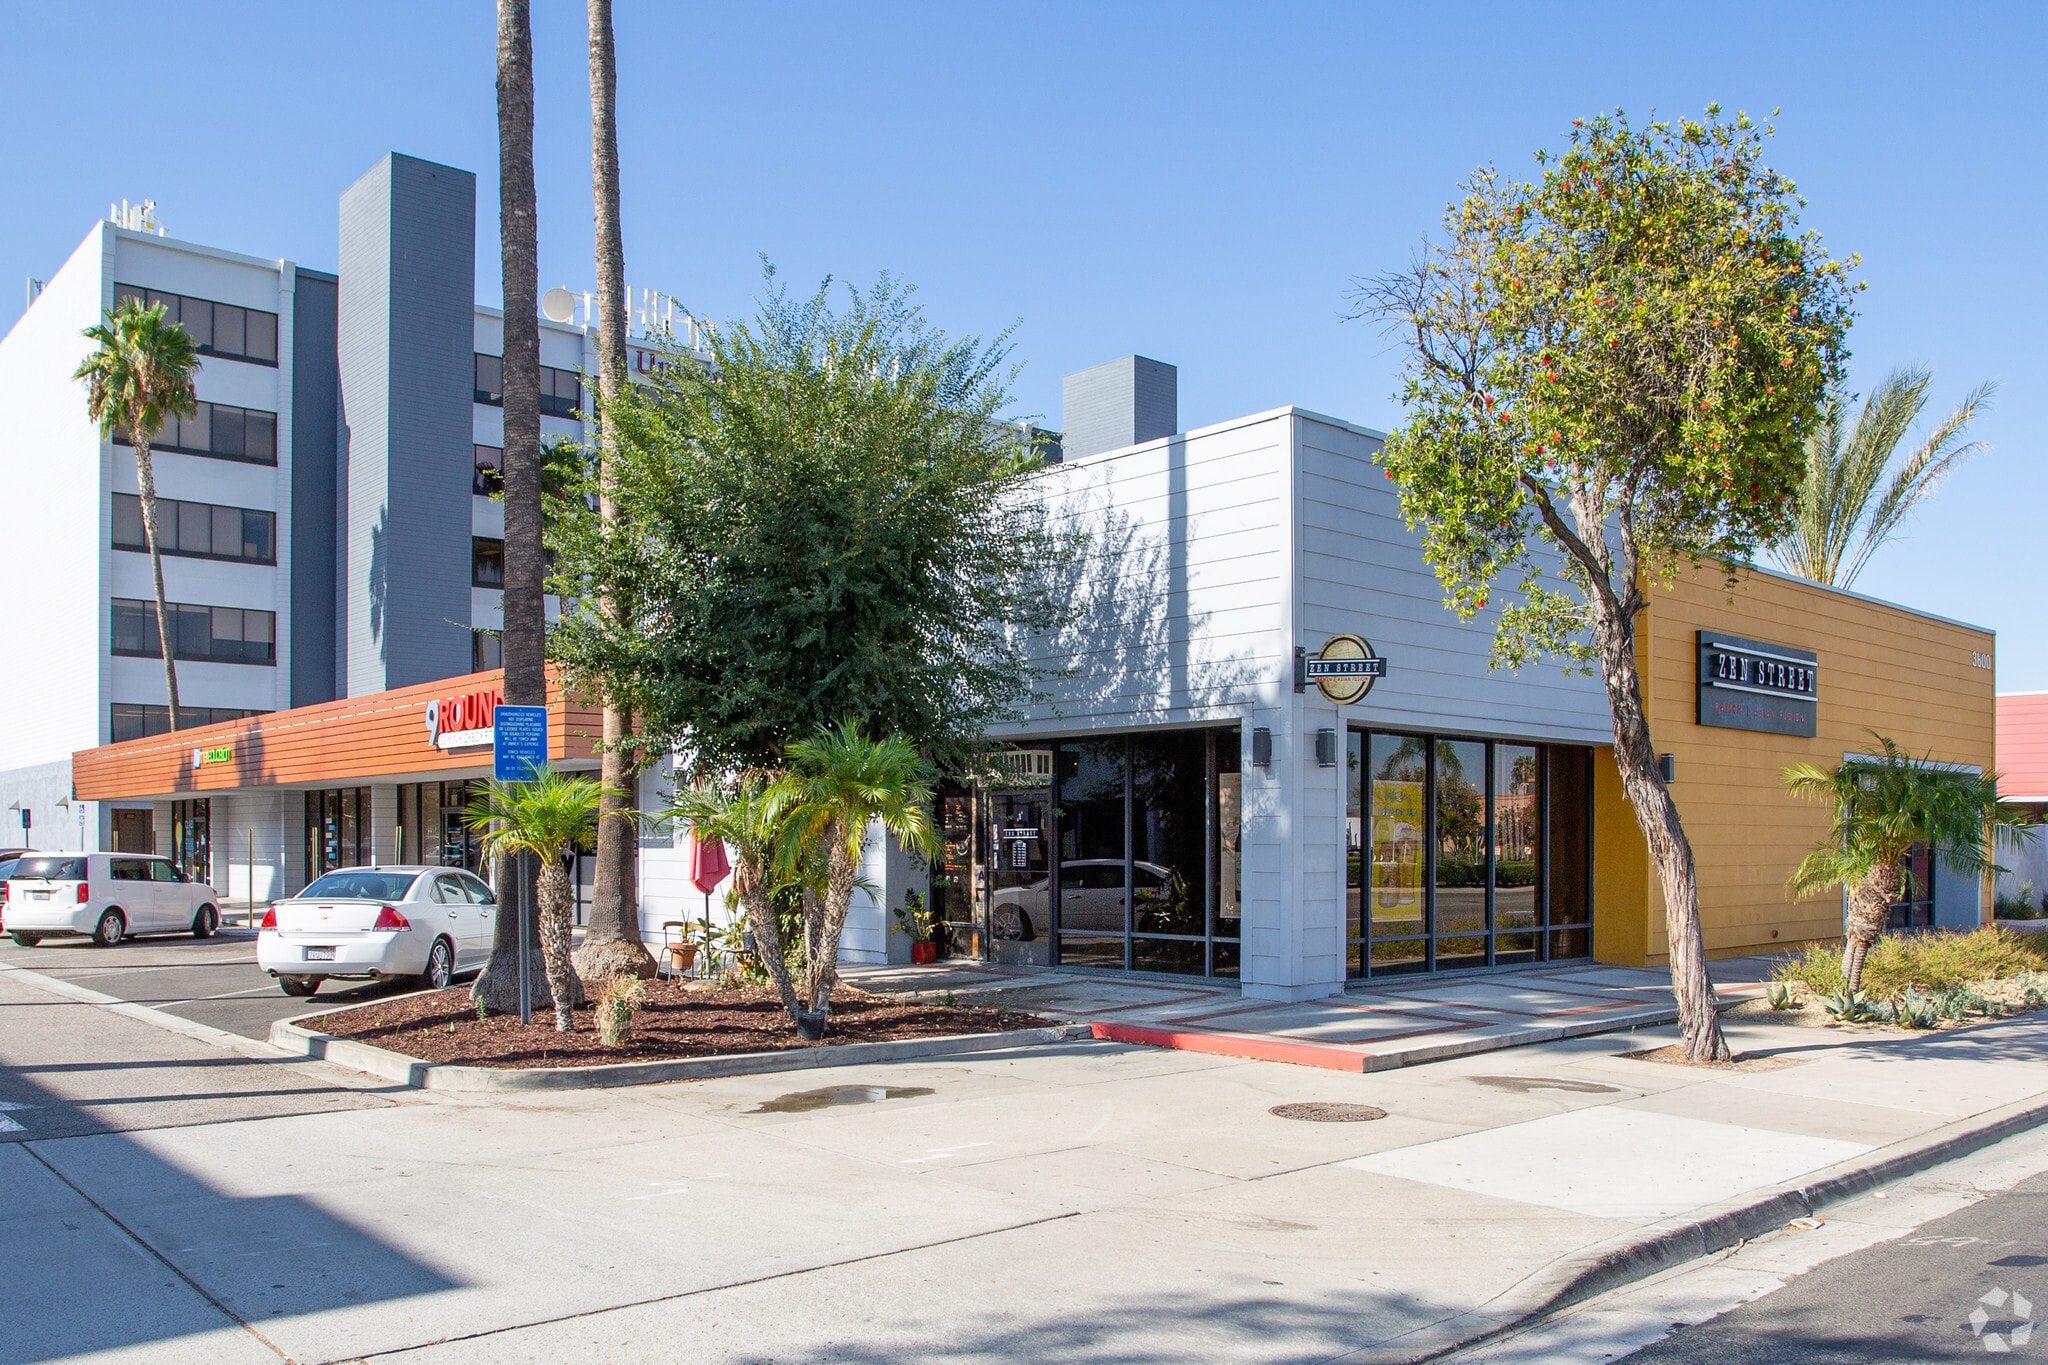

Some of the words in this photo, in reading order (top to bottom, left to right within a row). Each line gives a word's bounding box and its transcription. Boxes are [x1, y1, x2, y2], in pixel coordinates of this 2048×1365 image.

[1310, 664, 1330, 672] ZEN
[1336, 663, 1379, 672] STREET
[1972, 650, 1991, 670] 3600
[1718, 654, 1748, 681] ZEN
[1758, 661, 1814, 692] STREET
